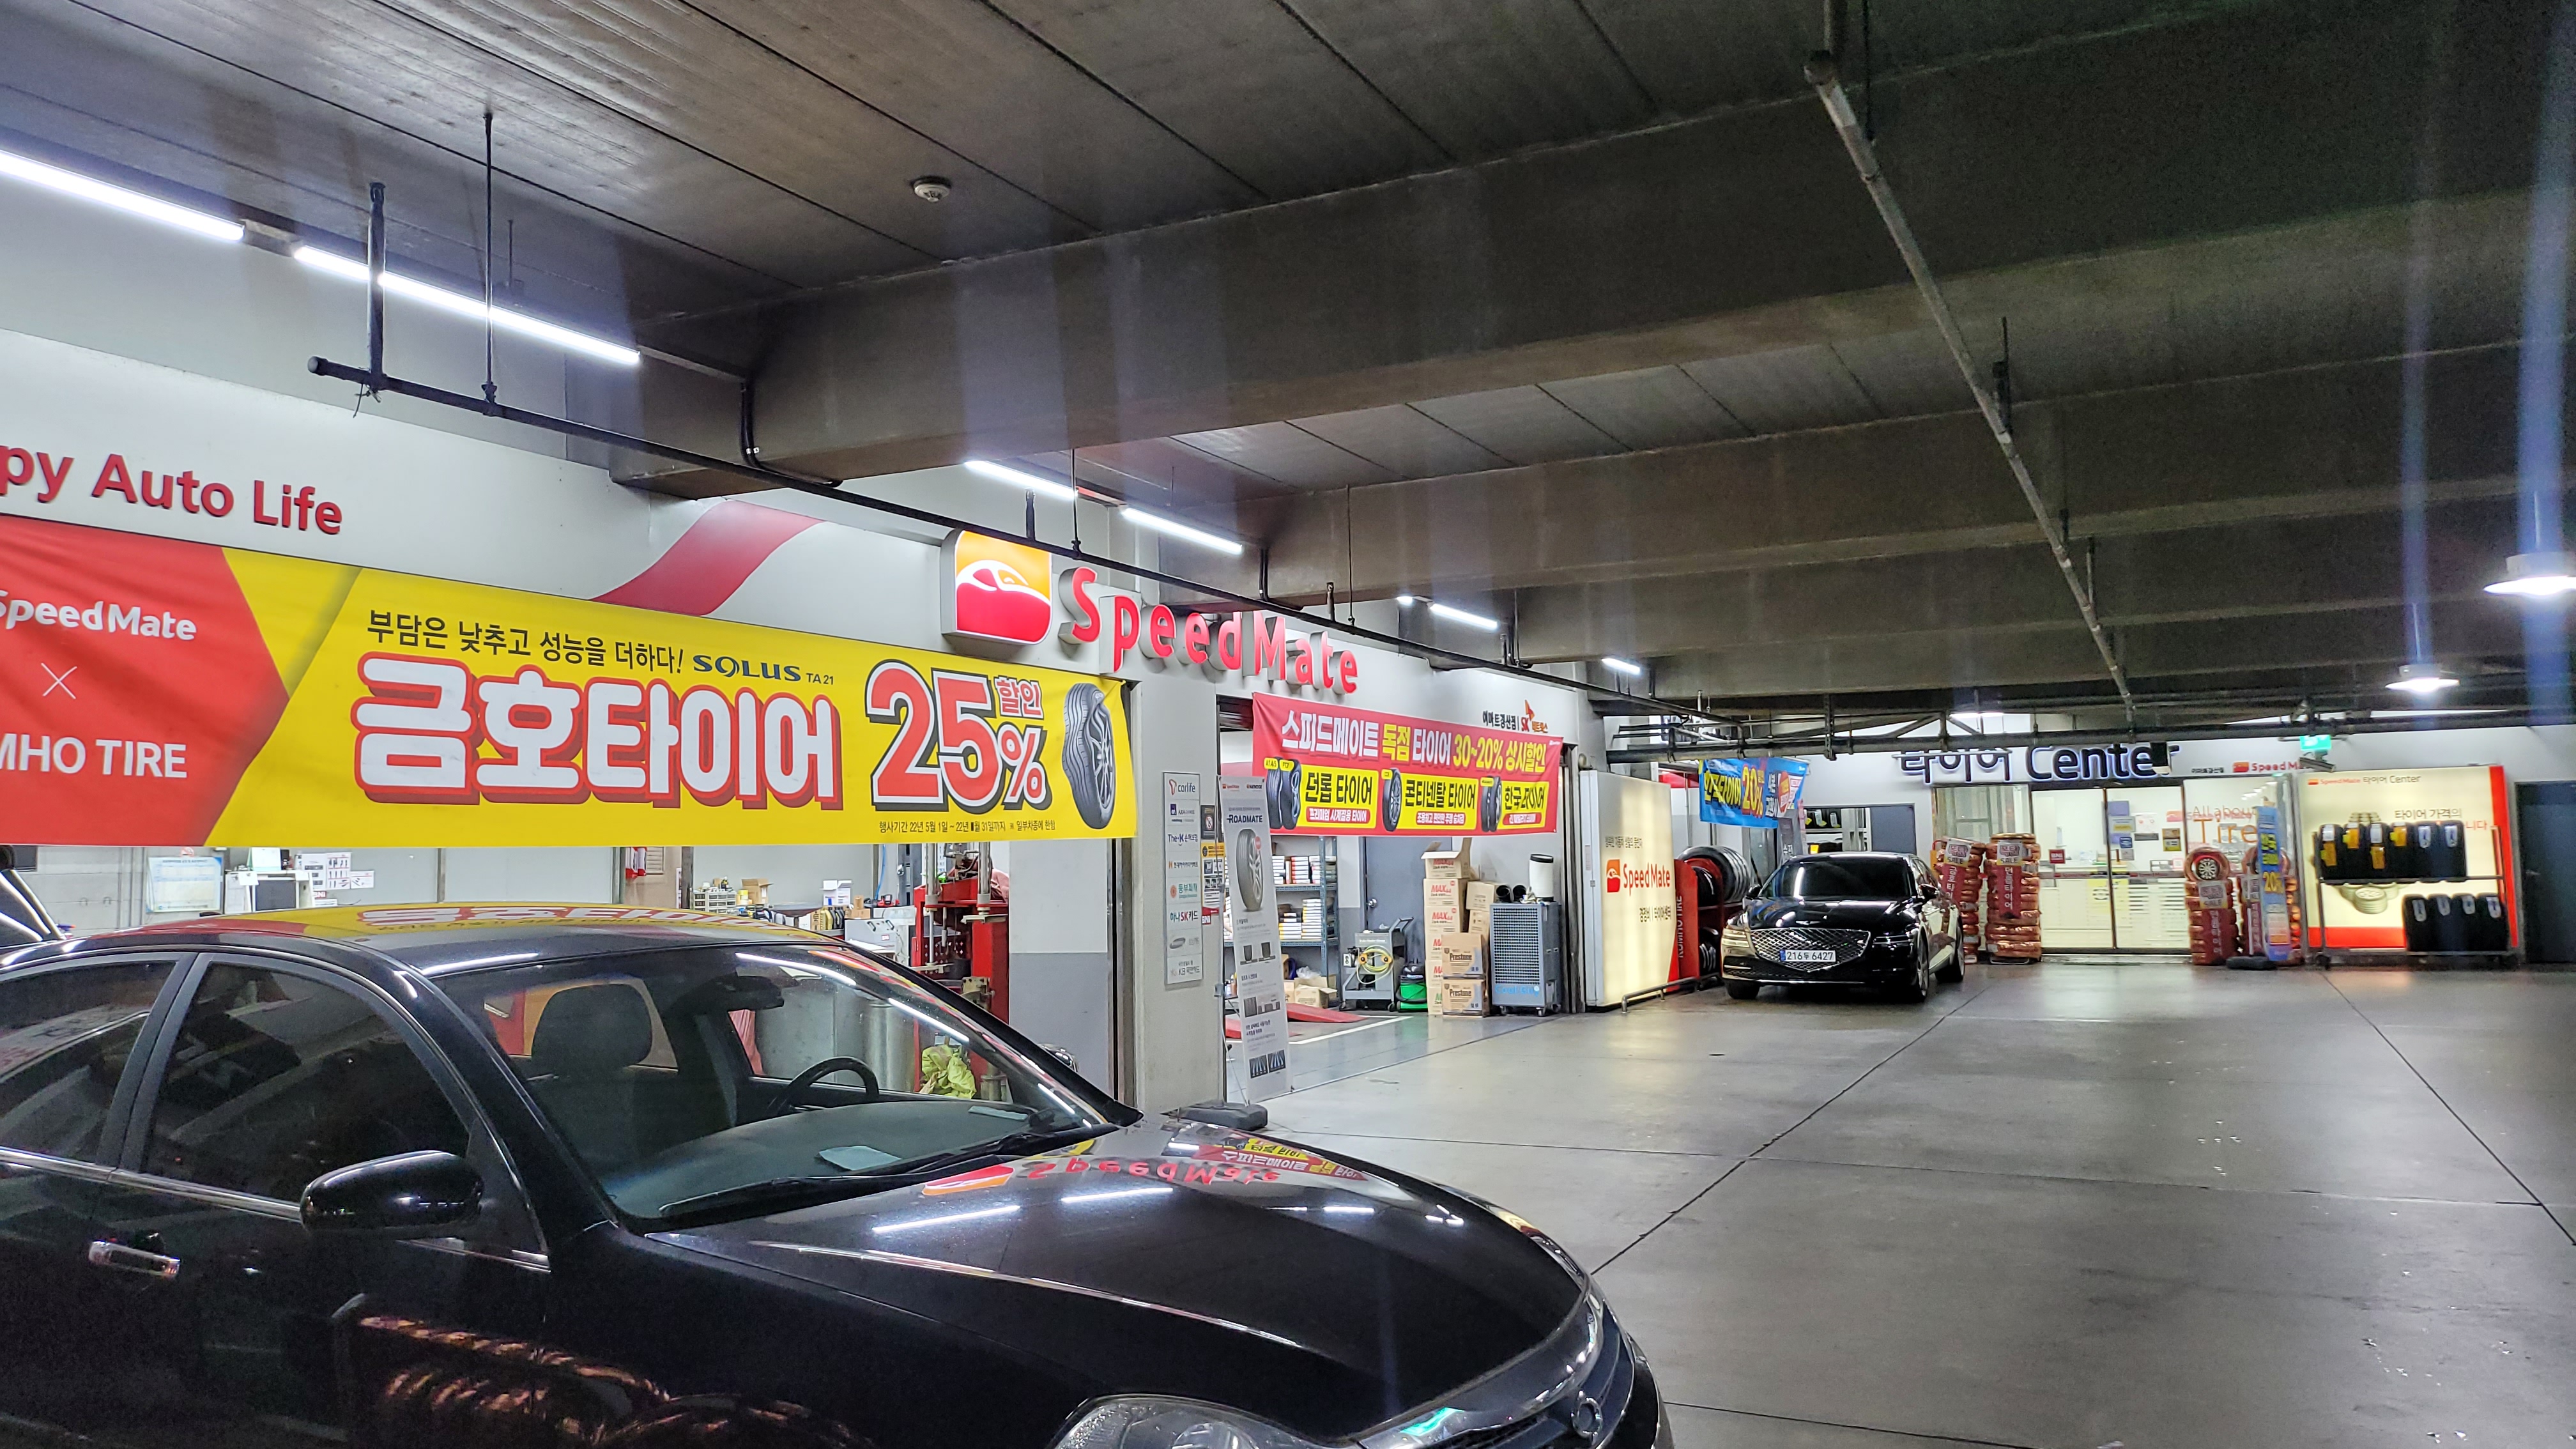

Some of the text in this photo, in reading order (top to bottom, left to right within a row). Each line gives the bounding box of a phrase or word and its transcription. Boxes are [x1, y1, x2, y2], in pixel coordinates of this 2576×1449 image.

[92, 454, 234, 518] Auto
[254, 479, 343, 535] Life
[1067, 565, 1360, 695] SpeedMate
[367, 609, 448, 650] 부담은
[457, 620, 532, 657] 낮추고
[540, 631, 607, 668] 성능을
[615, 641, 684, 675] 더하다!
[692, 654, 802, 682] SOLUS
[993, 675, 1045, 719] 할인
[351, 650, 844, 811] 금호타이어
[864, 658, 1054, 815] 25%
[1282, 709, 1547, 773] 스피드메이트 독점 타이어 30~20% 상시할인
[95, 739, 188, 779] TIRE
[1900, 750, 2012, 783] 타이어
[1177, 782, 1196, 793] carlife
[1305, 772, 1373, 805] 던롭 타이어
[2363, 776, 2387, 785] 타이어
[2389, 774, 2421, 783] Center
[1405, 779, 1476, 809] 콘티넨탈 타이어
[1505, 785, 1545, 810] 한국 타이어
[878, 821, 908, 834] 행사기간
[909, 822, 924, 833] 22년
[925, 821, 937, 833] 5월
[938, 820, 949, 833] 1일
[956, 821, 969, 832] 22년
[970, 820, 981, 832] 월
[981, 820, 1006, 832] 31일까지
[1016, 820, 1044, 832] 일부차종에
[1045, 819, 1056, 831] 한함
[1226, 814, 1263, 824] ROADMATE
[1309, 808, 1330, 822] 프리미엄
[1352, 810, 1367, 822] 타이어
[2395, 808, 2462, 820] 타이어 가격의
[2193, 818, 2258, 845] Tire
[1623, 862, 1671, 897] SpeedMate
[1170, 910, 1199, 923] 하나SK카드
[1449, 953, 1472, 961] Prestone
[1787, 952, 1833, 960] 216두 6427
[1449, 988, 1472, 997] Prestone
